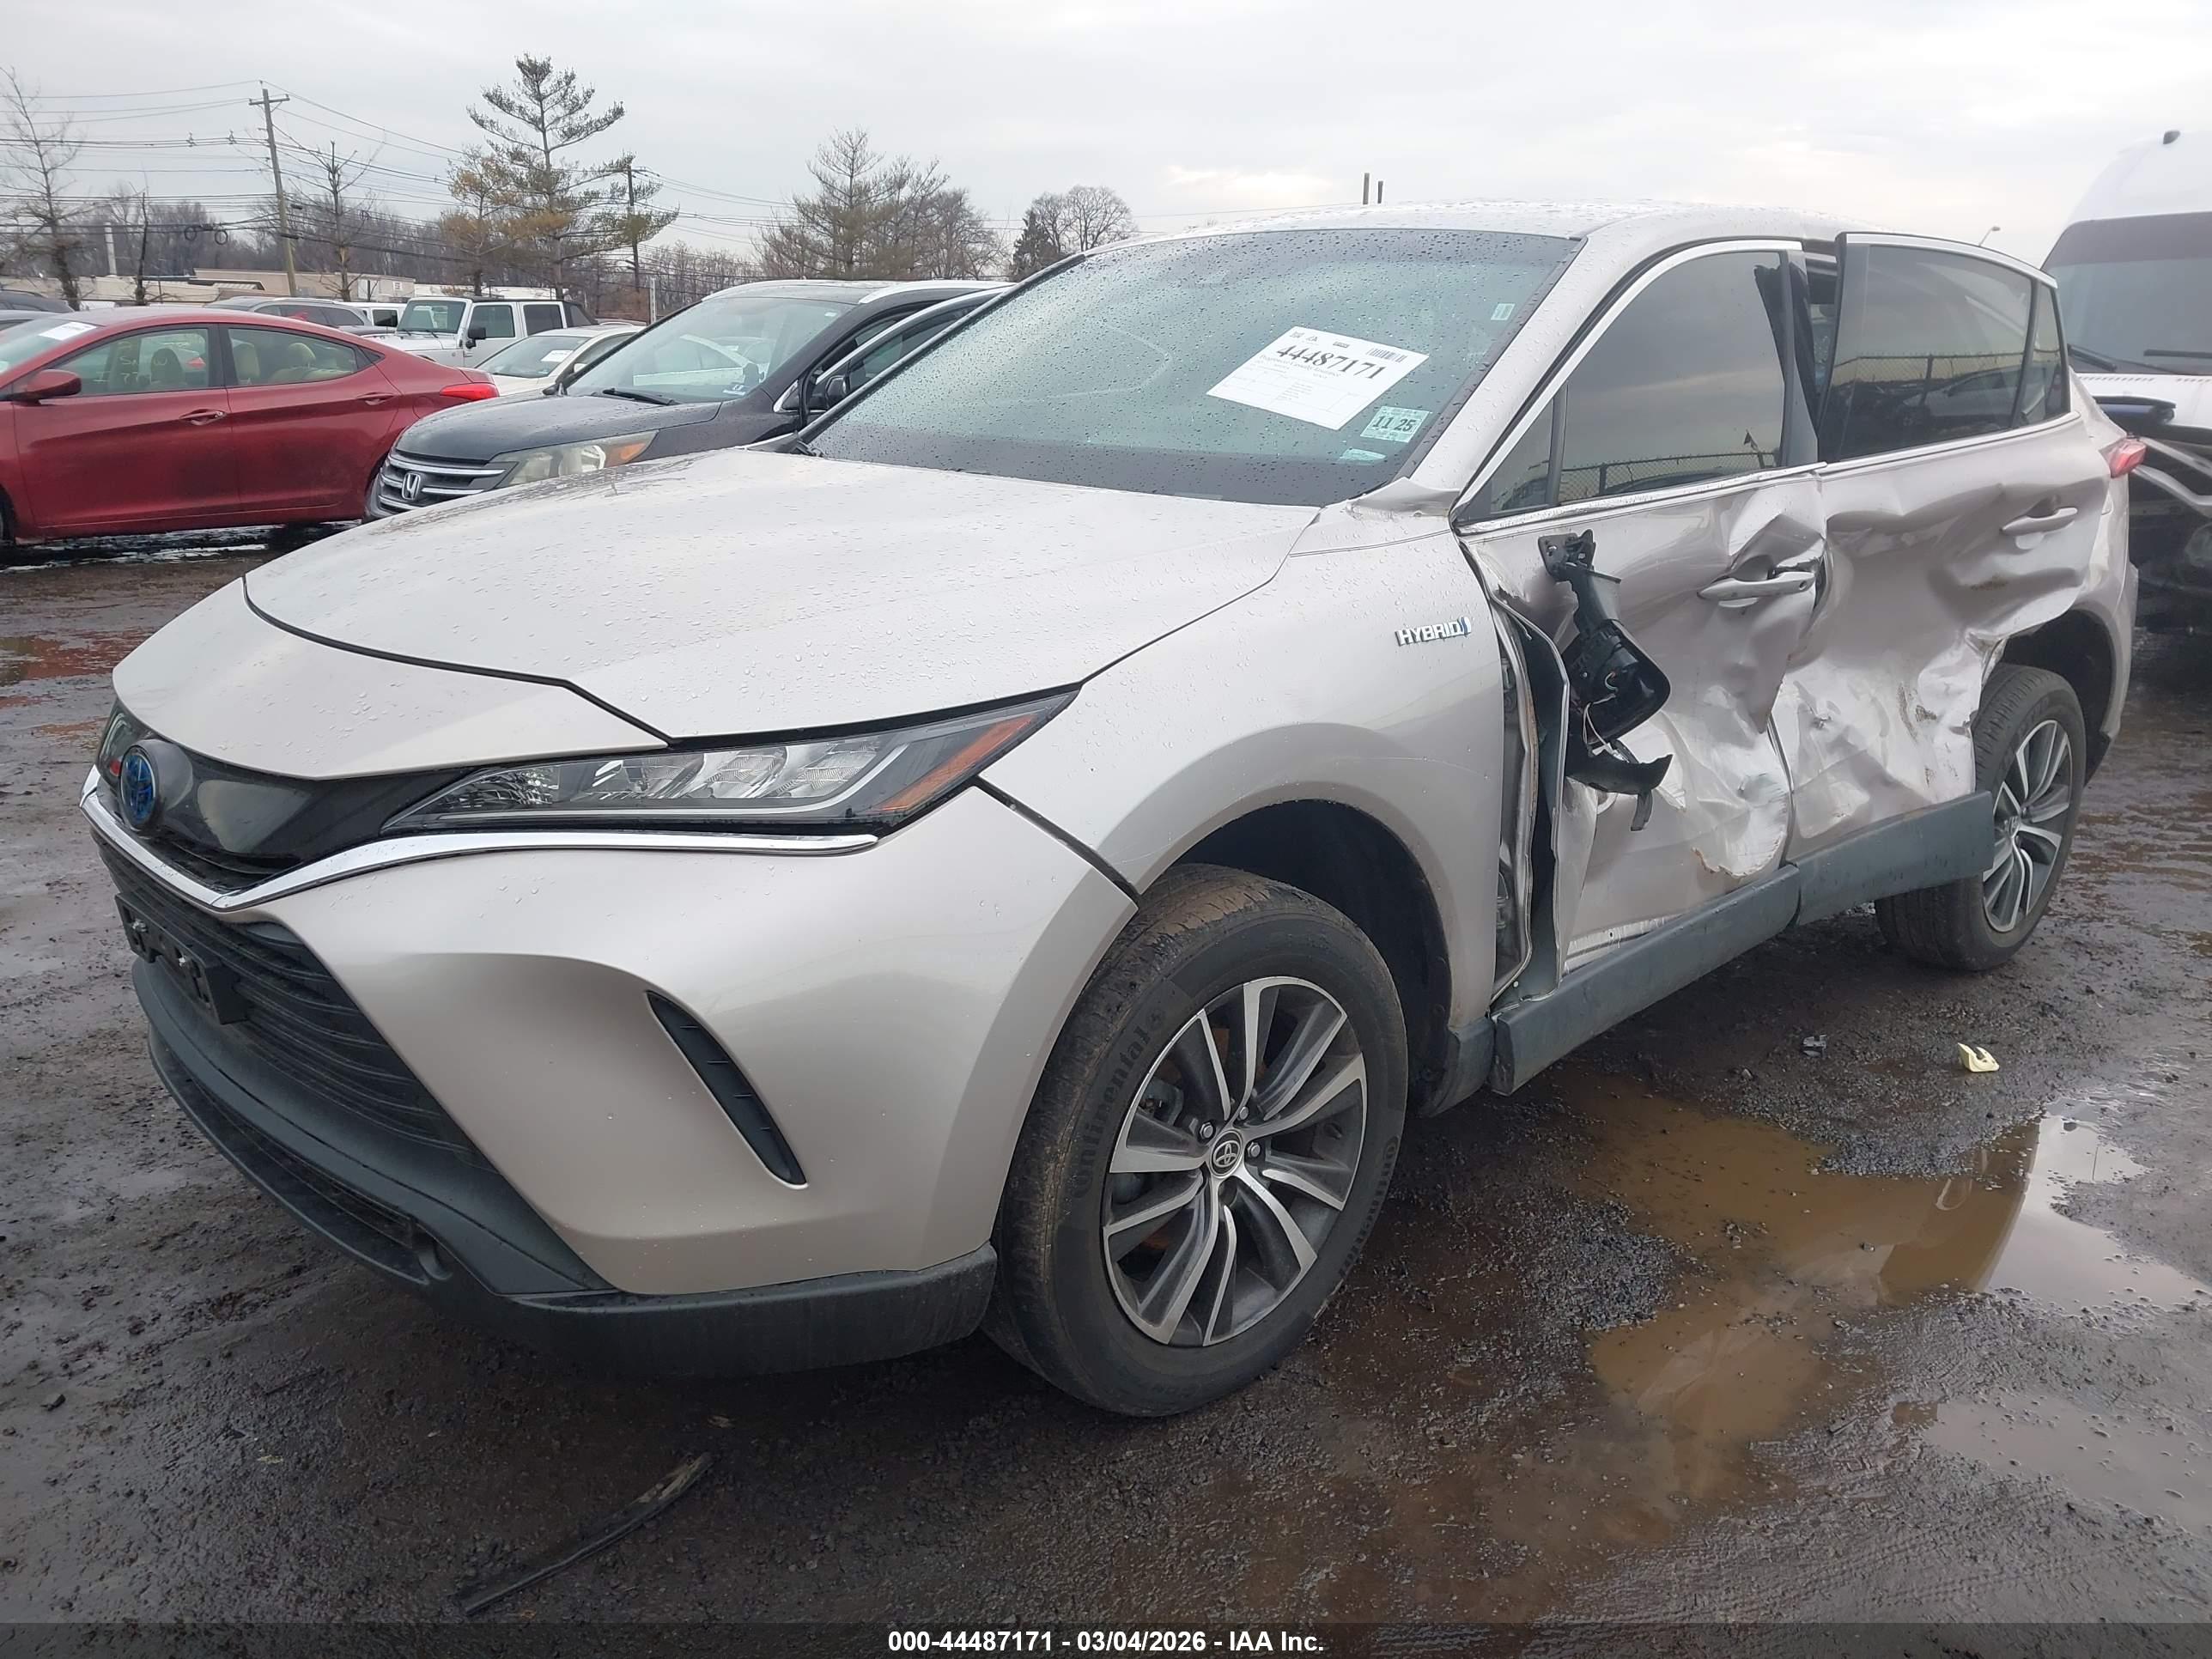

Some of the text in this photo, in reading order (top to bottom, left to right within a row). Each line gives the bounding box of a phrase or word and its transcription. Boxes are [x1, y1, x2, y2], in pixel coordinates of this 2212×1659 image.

[1276, 345, 1386, 379] 44487171
[1372, 416, 1416, 431] 11 25
[1395, 620, 1462, 646] HYBRID
